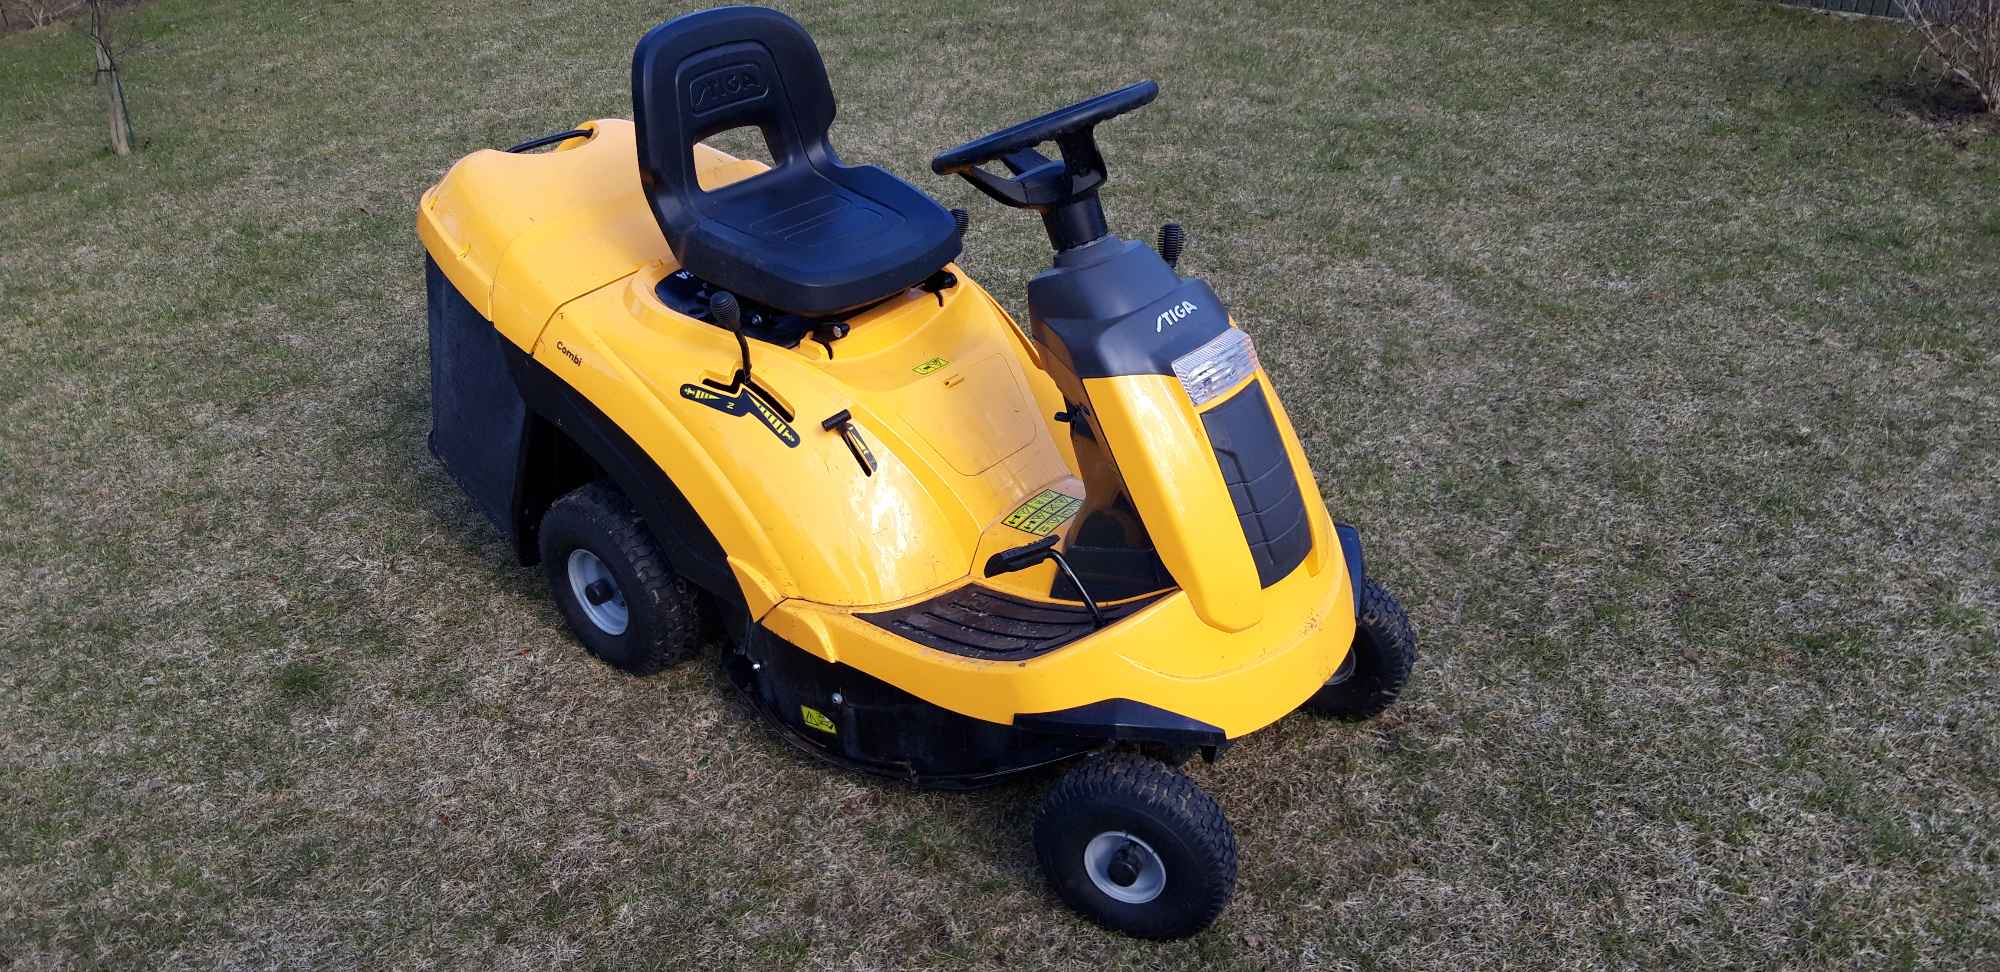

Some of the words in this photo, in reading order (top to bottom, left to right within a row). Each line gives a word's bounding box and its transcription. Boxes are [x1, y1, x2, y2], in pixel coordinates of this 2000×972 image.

[696, 71, 762, 106] STIGA
[1156, 300, 1198, 333] STIGA
[556, 340, 583, 367] Combi
